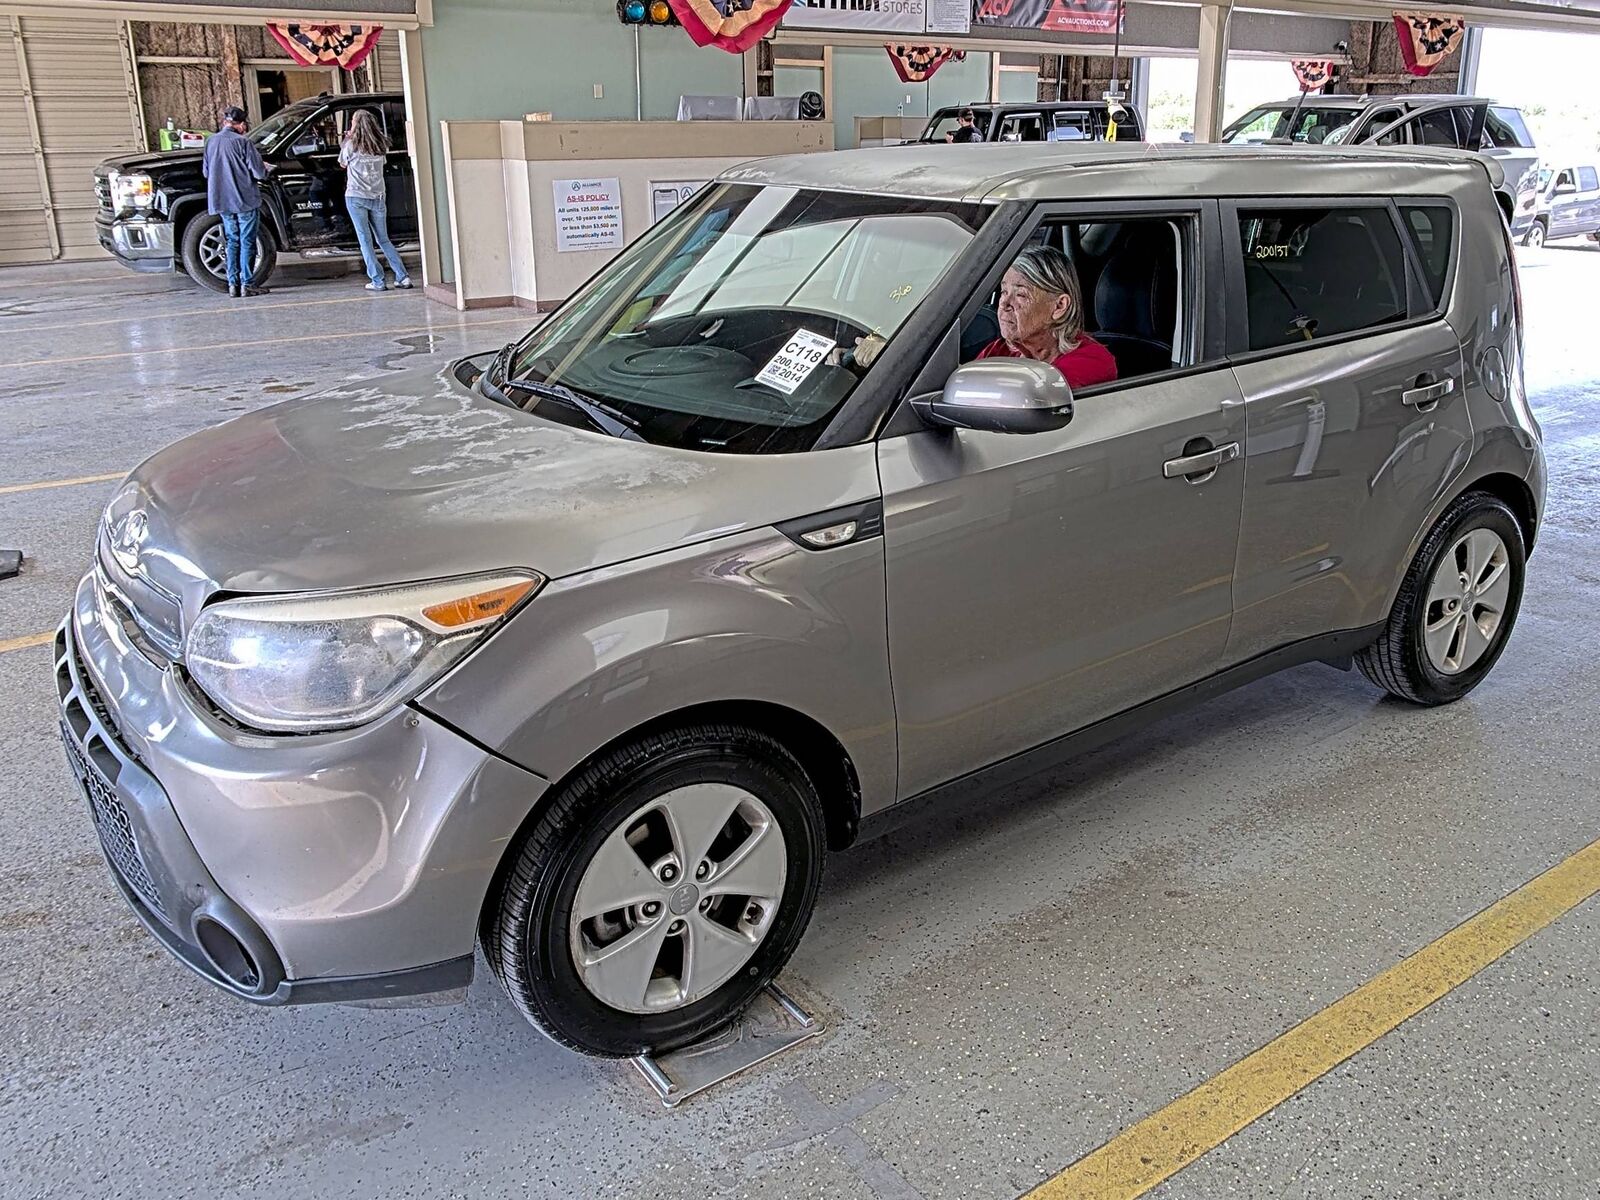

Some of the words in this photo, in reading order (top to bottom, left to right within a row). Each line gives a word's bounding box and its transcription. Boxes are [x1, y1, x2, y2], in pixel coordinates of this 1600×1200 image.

[883, 1, 923, 15] STORES
[1057, 17, 1109, 27] ACVAUCTIONS.COM
[1256, 244, 1288, 259] 200137
[785, 342, 822, 363] C118
[773, 355, 811, 374] 200,137
[778, 368, 803, 383] 2014
